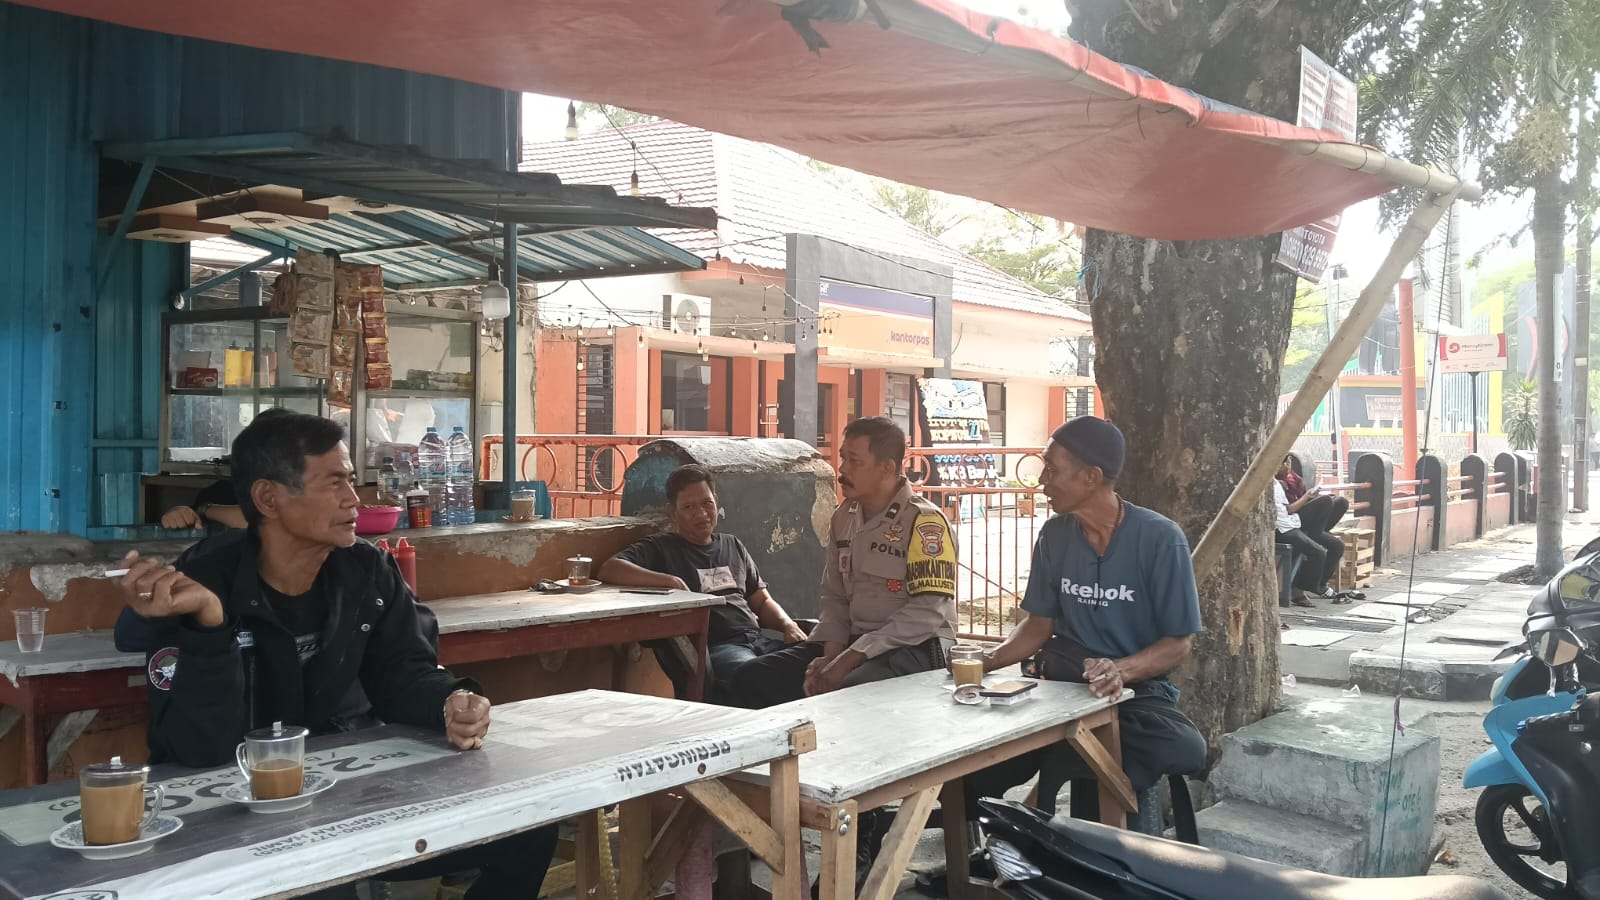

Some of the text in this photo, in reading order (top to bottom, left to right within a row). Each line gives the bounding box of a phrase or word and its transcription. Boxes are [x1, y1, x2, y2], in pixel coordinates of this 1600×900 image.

[870, 542, 906, 558] POLRI
[1061, 577, 1136, 602] Reebok
[248, 805, 420, 852] PEREMPUAN HAMIL
